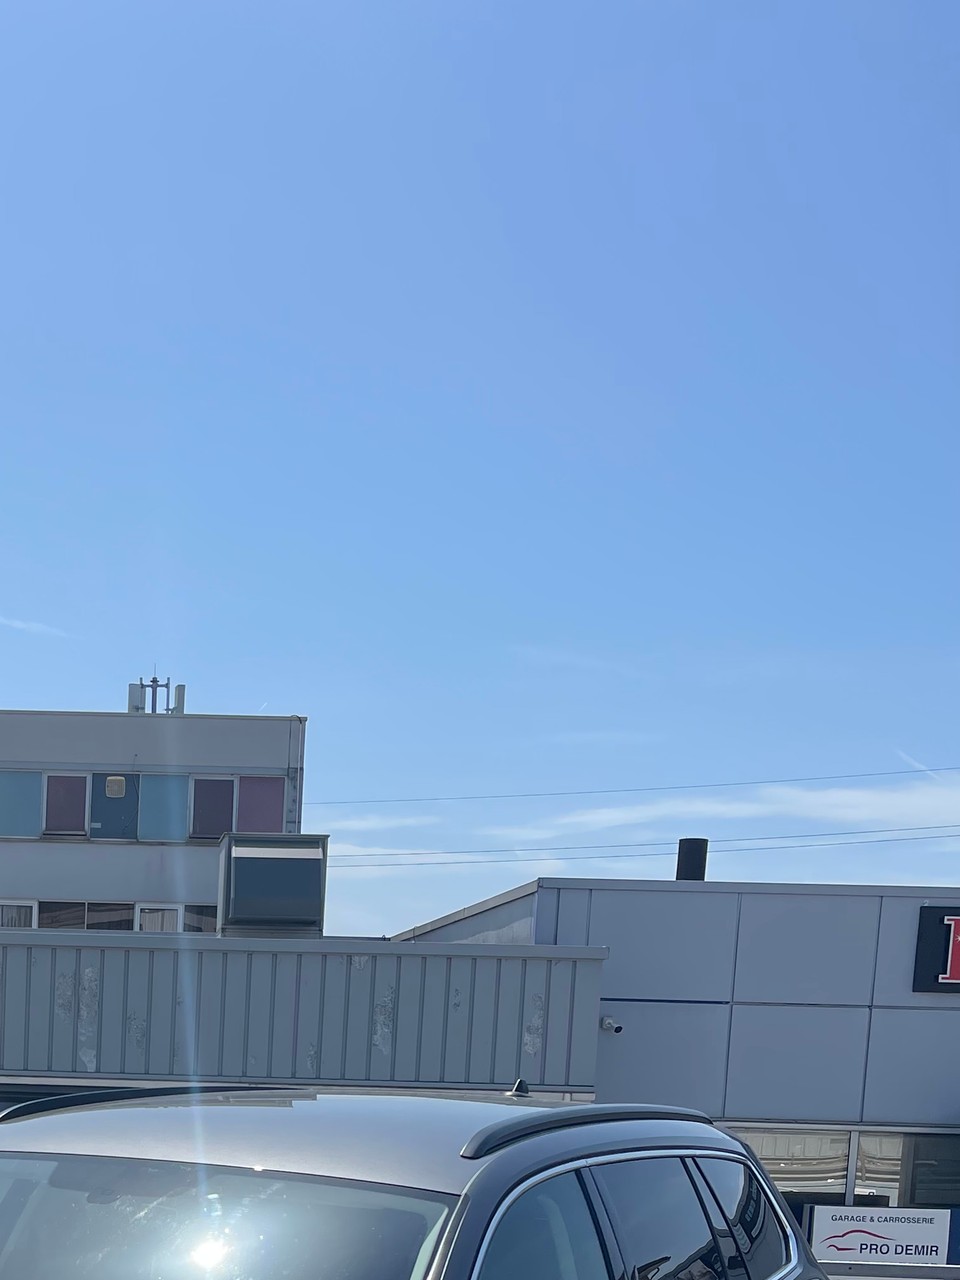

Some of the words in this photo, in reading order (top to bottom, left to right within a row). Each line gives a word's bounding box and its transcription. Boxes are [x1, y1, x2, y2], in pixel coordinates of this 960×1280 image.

[831, 1214, 867, 1223] GARAGE
[877, 1216, 935, 1225] CARROSSERIE
[859, 1243, 890, 1255] PRO
[894, 1244, 939, 1256] DEMIR
